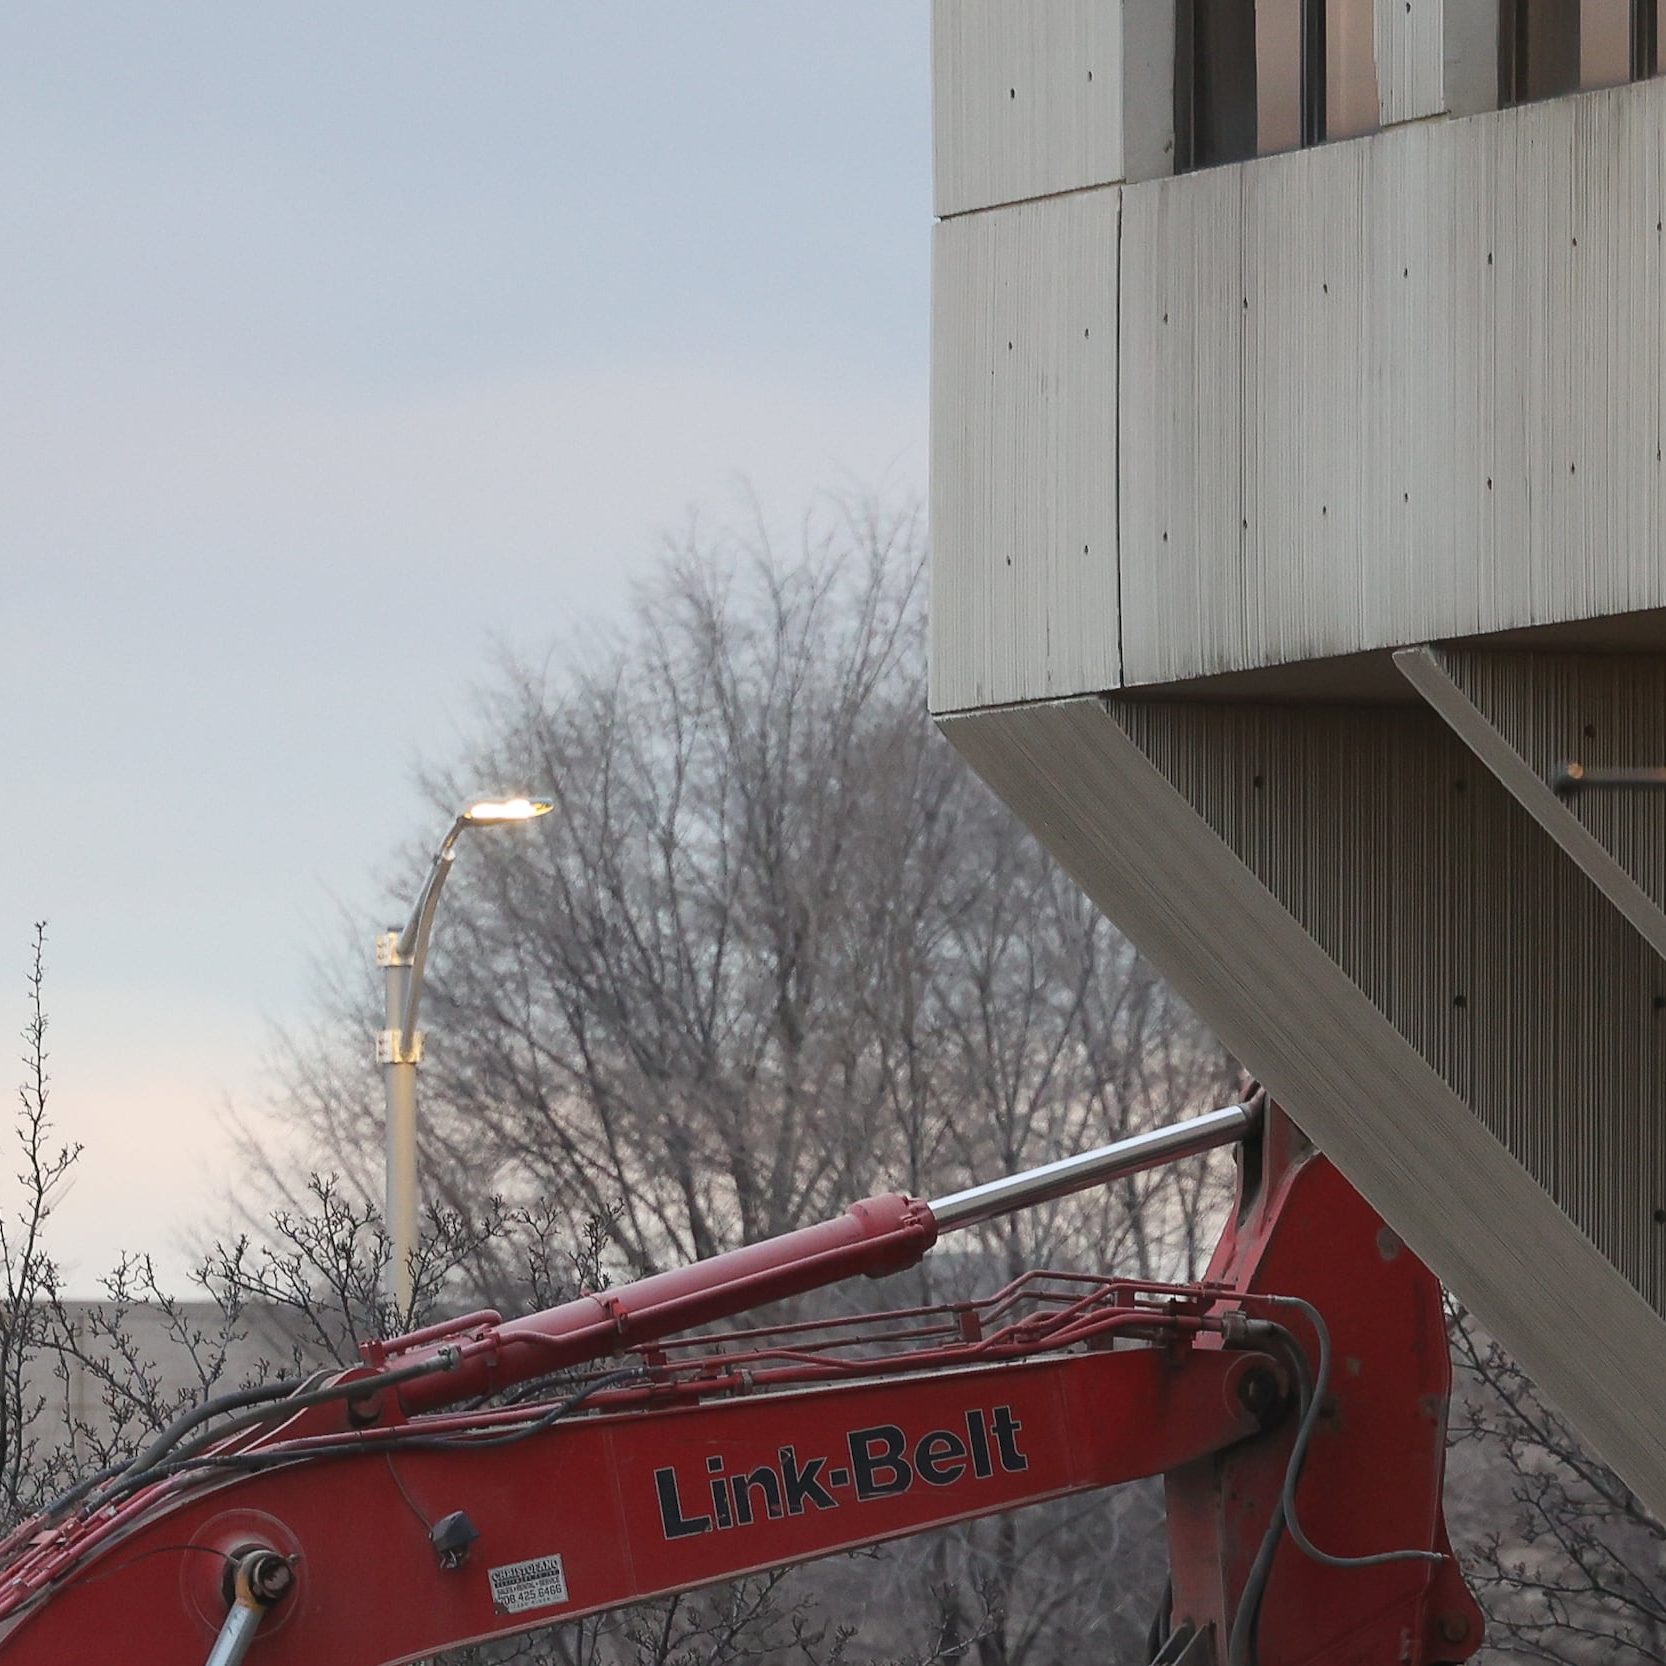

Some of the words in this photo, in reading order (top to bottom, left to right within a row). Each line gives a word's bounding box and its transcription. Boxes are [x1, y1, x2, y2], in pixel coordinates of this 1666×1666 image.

[653, 1404, 1029, 1541] Link-Belt
[518, 1589, 536, 1602] 425
[538, 1584, 562, 1598] 6466
